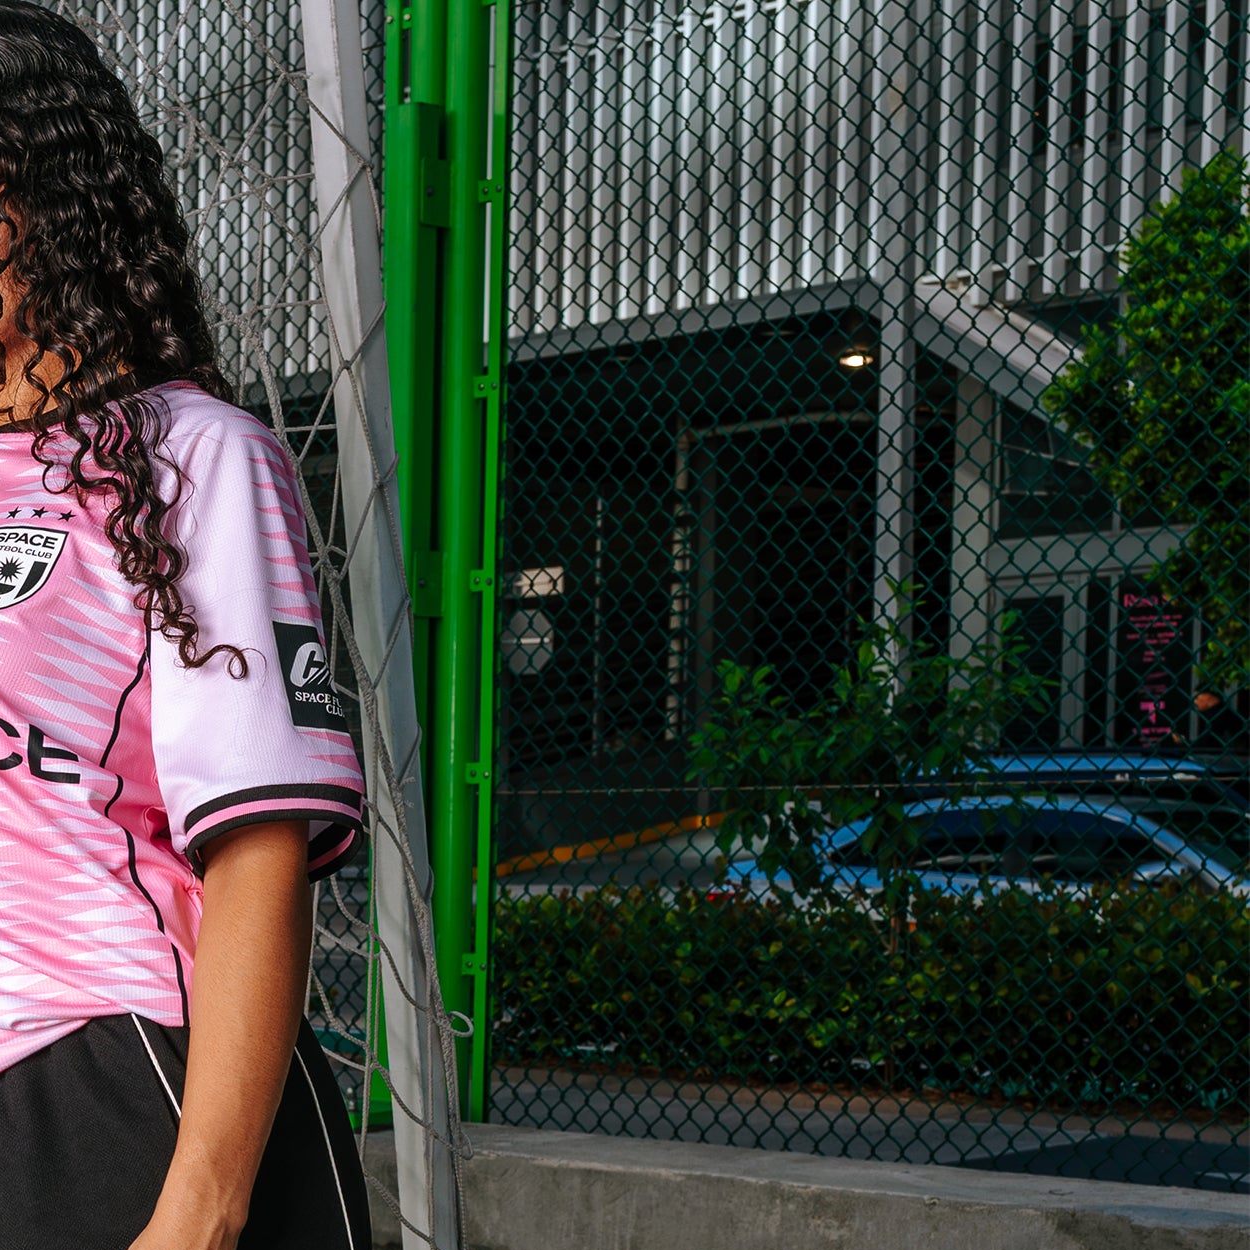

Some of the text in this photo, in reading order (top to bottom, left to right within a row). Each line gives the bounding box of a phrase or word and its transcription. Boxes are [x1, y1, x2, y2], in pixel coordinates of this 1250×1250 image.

[24, 548, 53, 559] CLUB
[294, 690, 332, 704] SPACE
[326, 704, 346, 718] CLU
